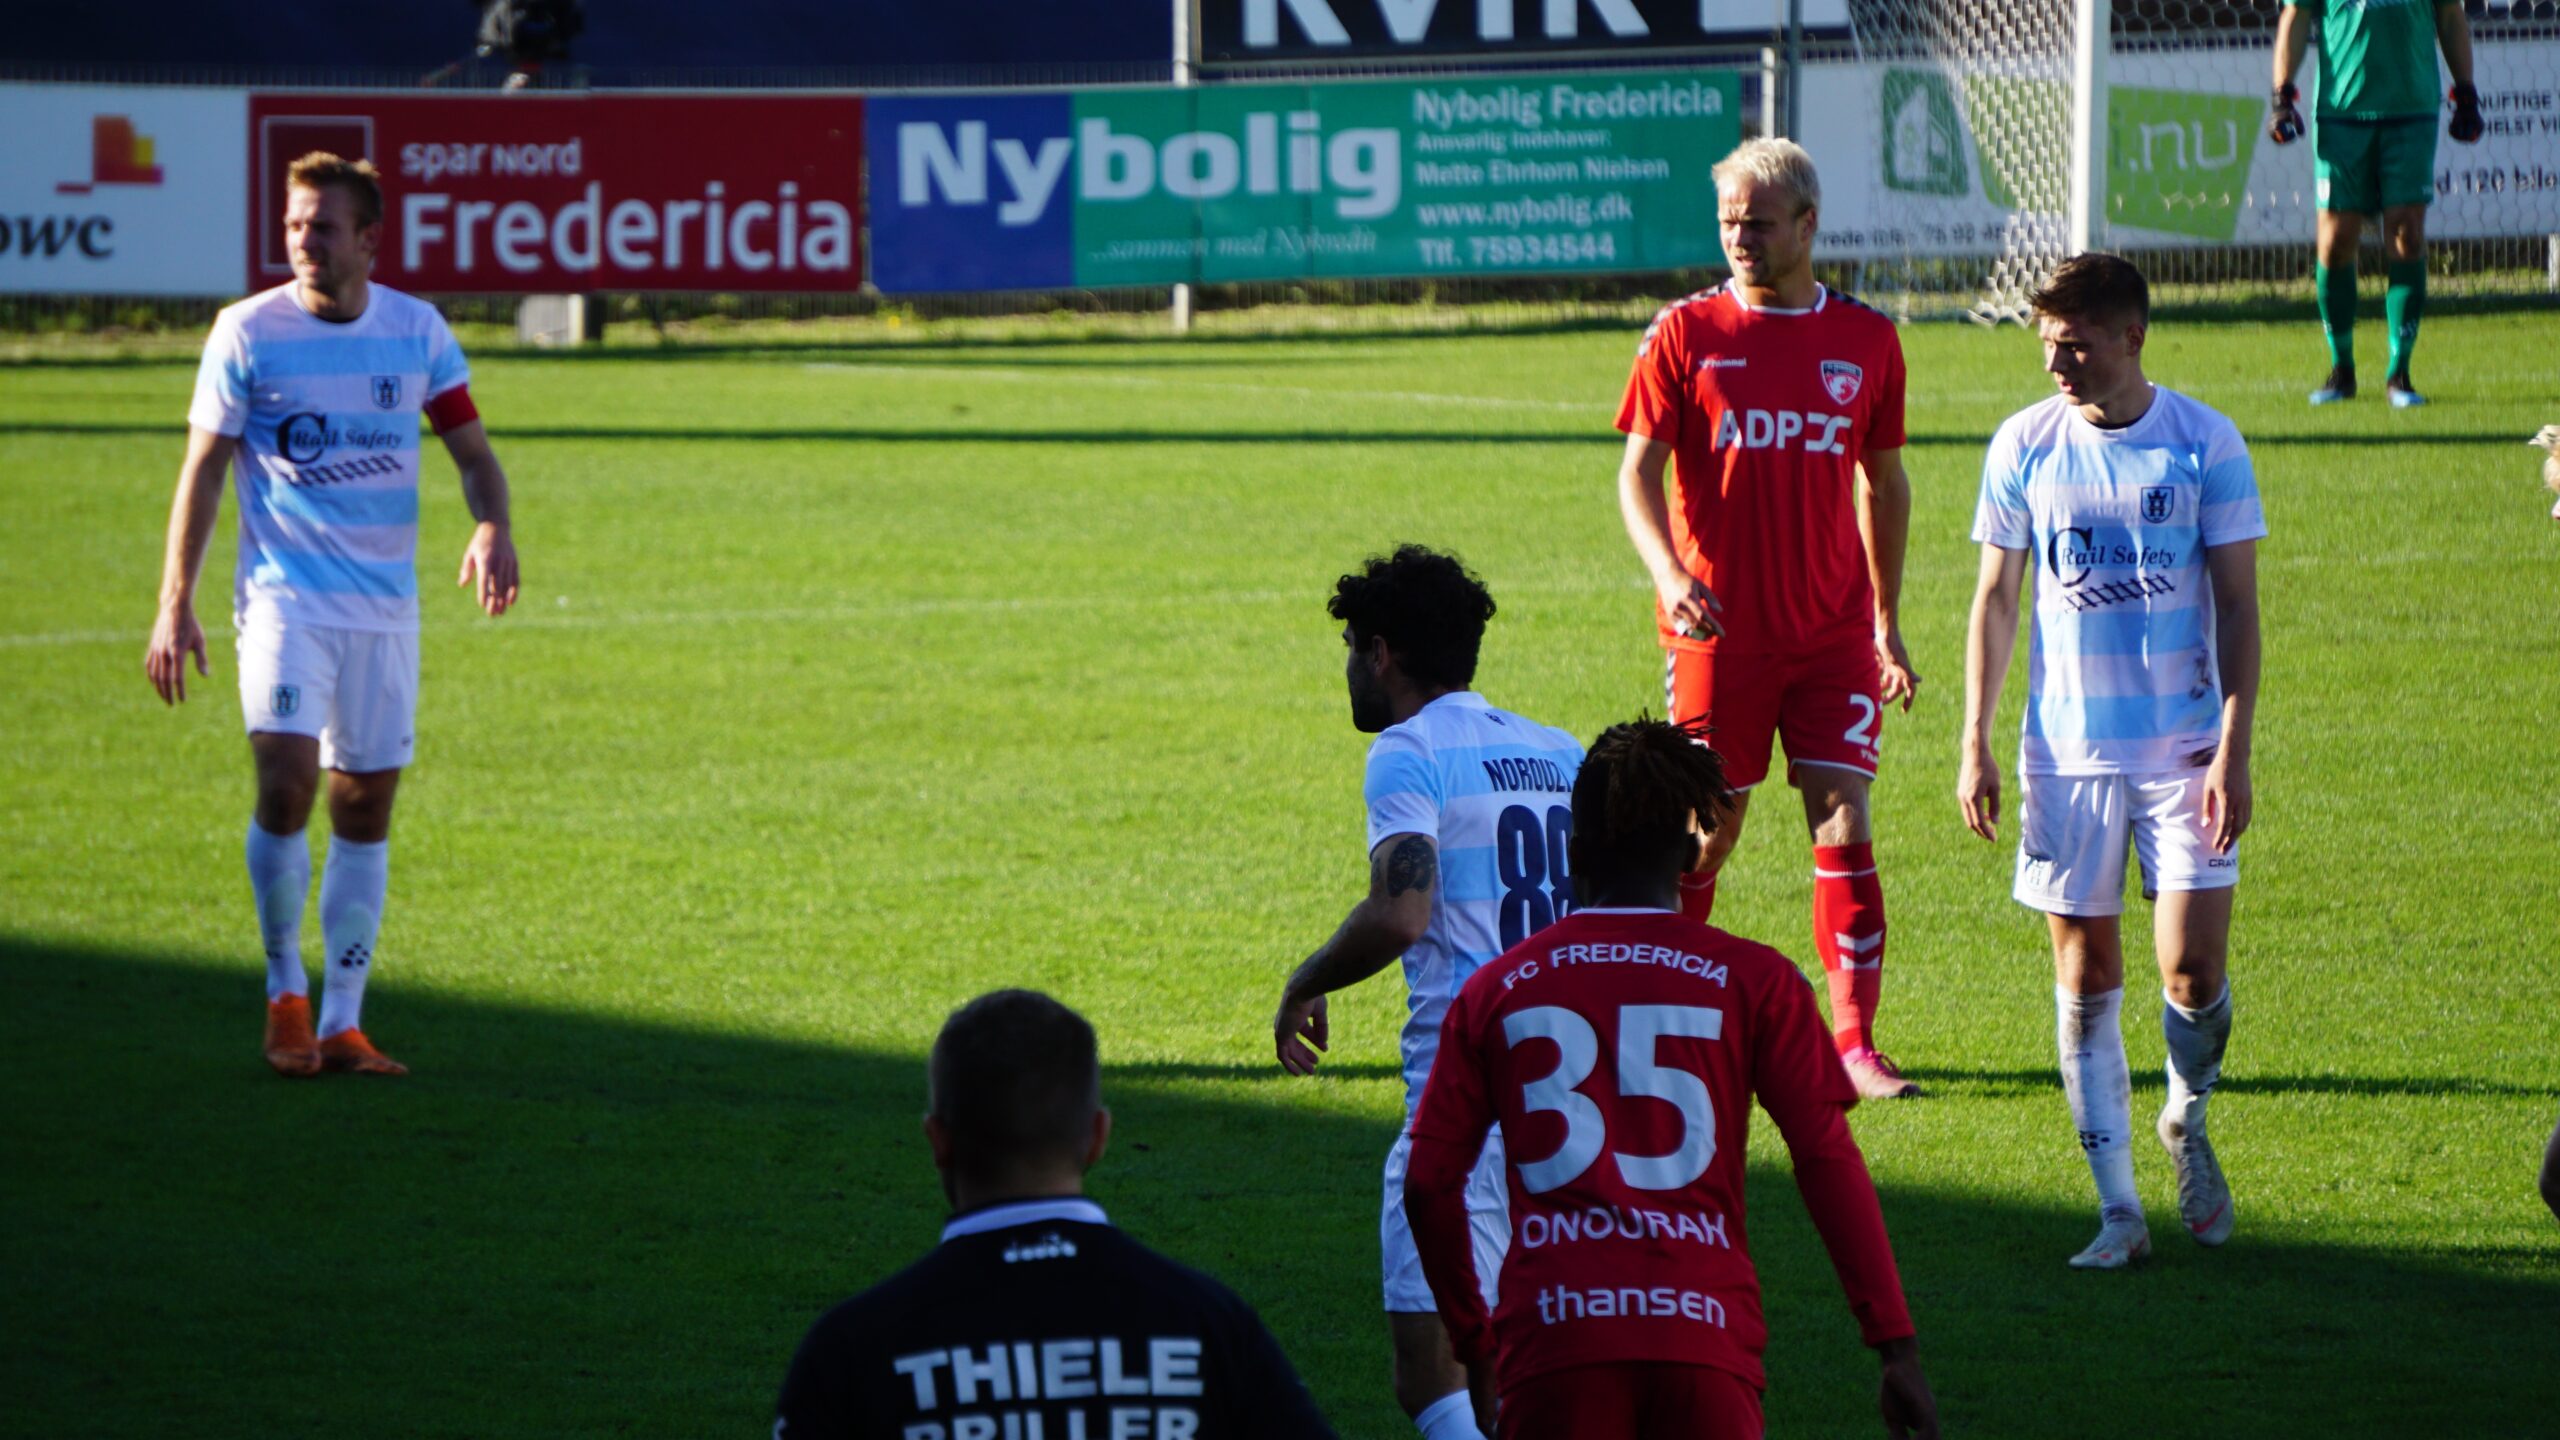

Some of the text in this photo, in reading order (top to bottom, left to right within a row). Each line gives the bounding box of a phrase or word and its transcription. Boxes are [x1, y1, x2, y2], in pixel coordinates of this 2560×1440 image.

[1413, 79, 1724, 129] Nybolig Fredericia
[2478, 89, 2552, 111] NUFTIGE
[898, 111, 1401, 227] Nybolig
[1415, 161, 1484, 186] Mette
[1584, 156, 1670, 181] Nielsen
[402, 180, 852, 274] Fredericia
[1418, 192, 1633, 229] www.nybolig.dk
[1470, 232, 1616, 265] 75934544
[1716, 409, 1803, 449] ADP
[2112, 545, 2176, 568] Safety
[1844, 693, 1883, 752] 2
[1503, 943, 1729, 990] FC FREDERICIA
[1503, 1005, 1723, 1195] 35
[1521, 1206, 1731, 1250] ONOURAH
[1537, 1284, 1726, 1329] thansen
[894, 1338, 1203, 1411] THIELE
